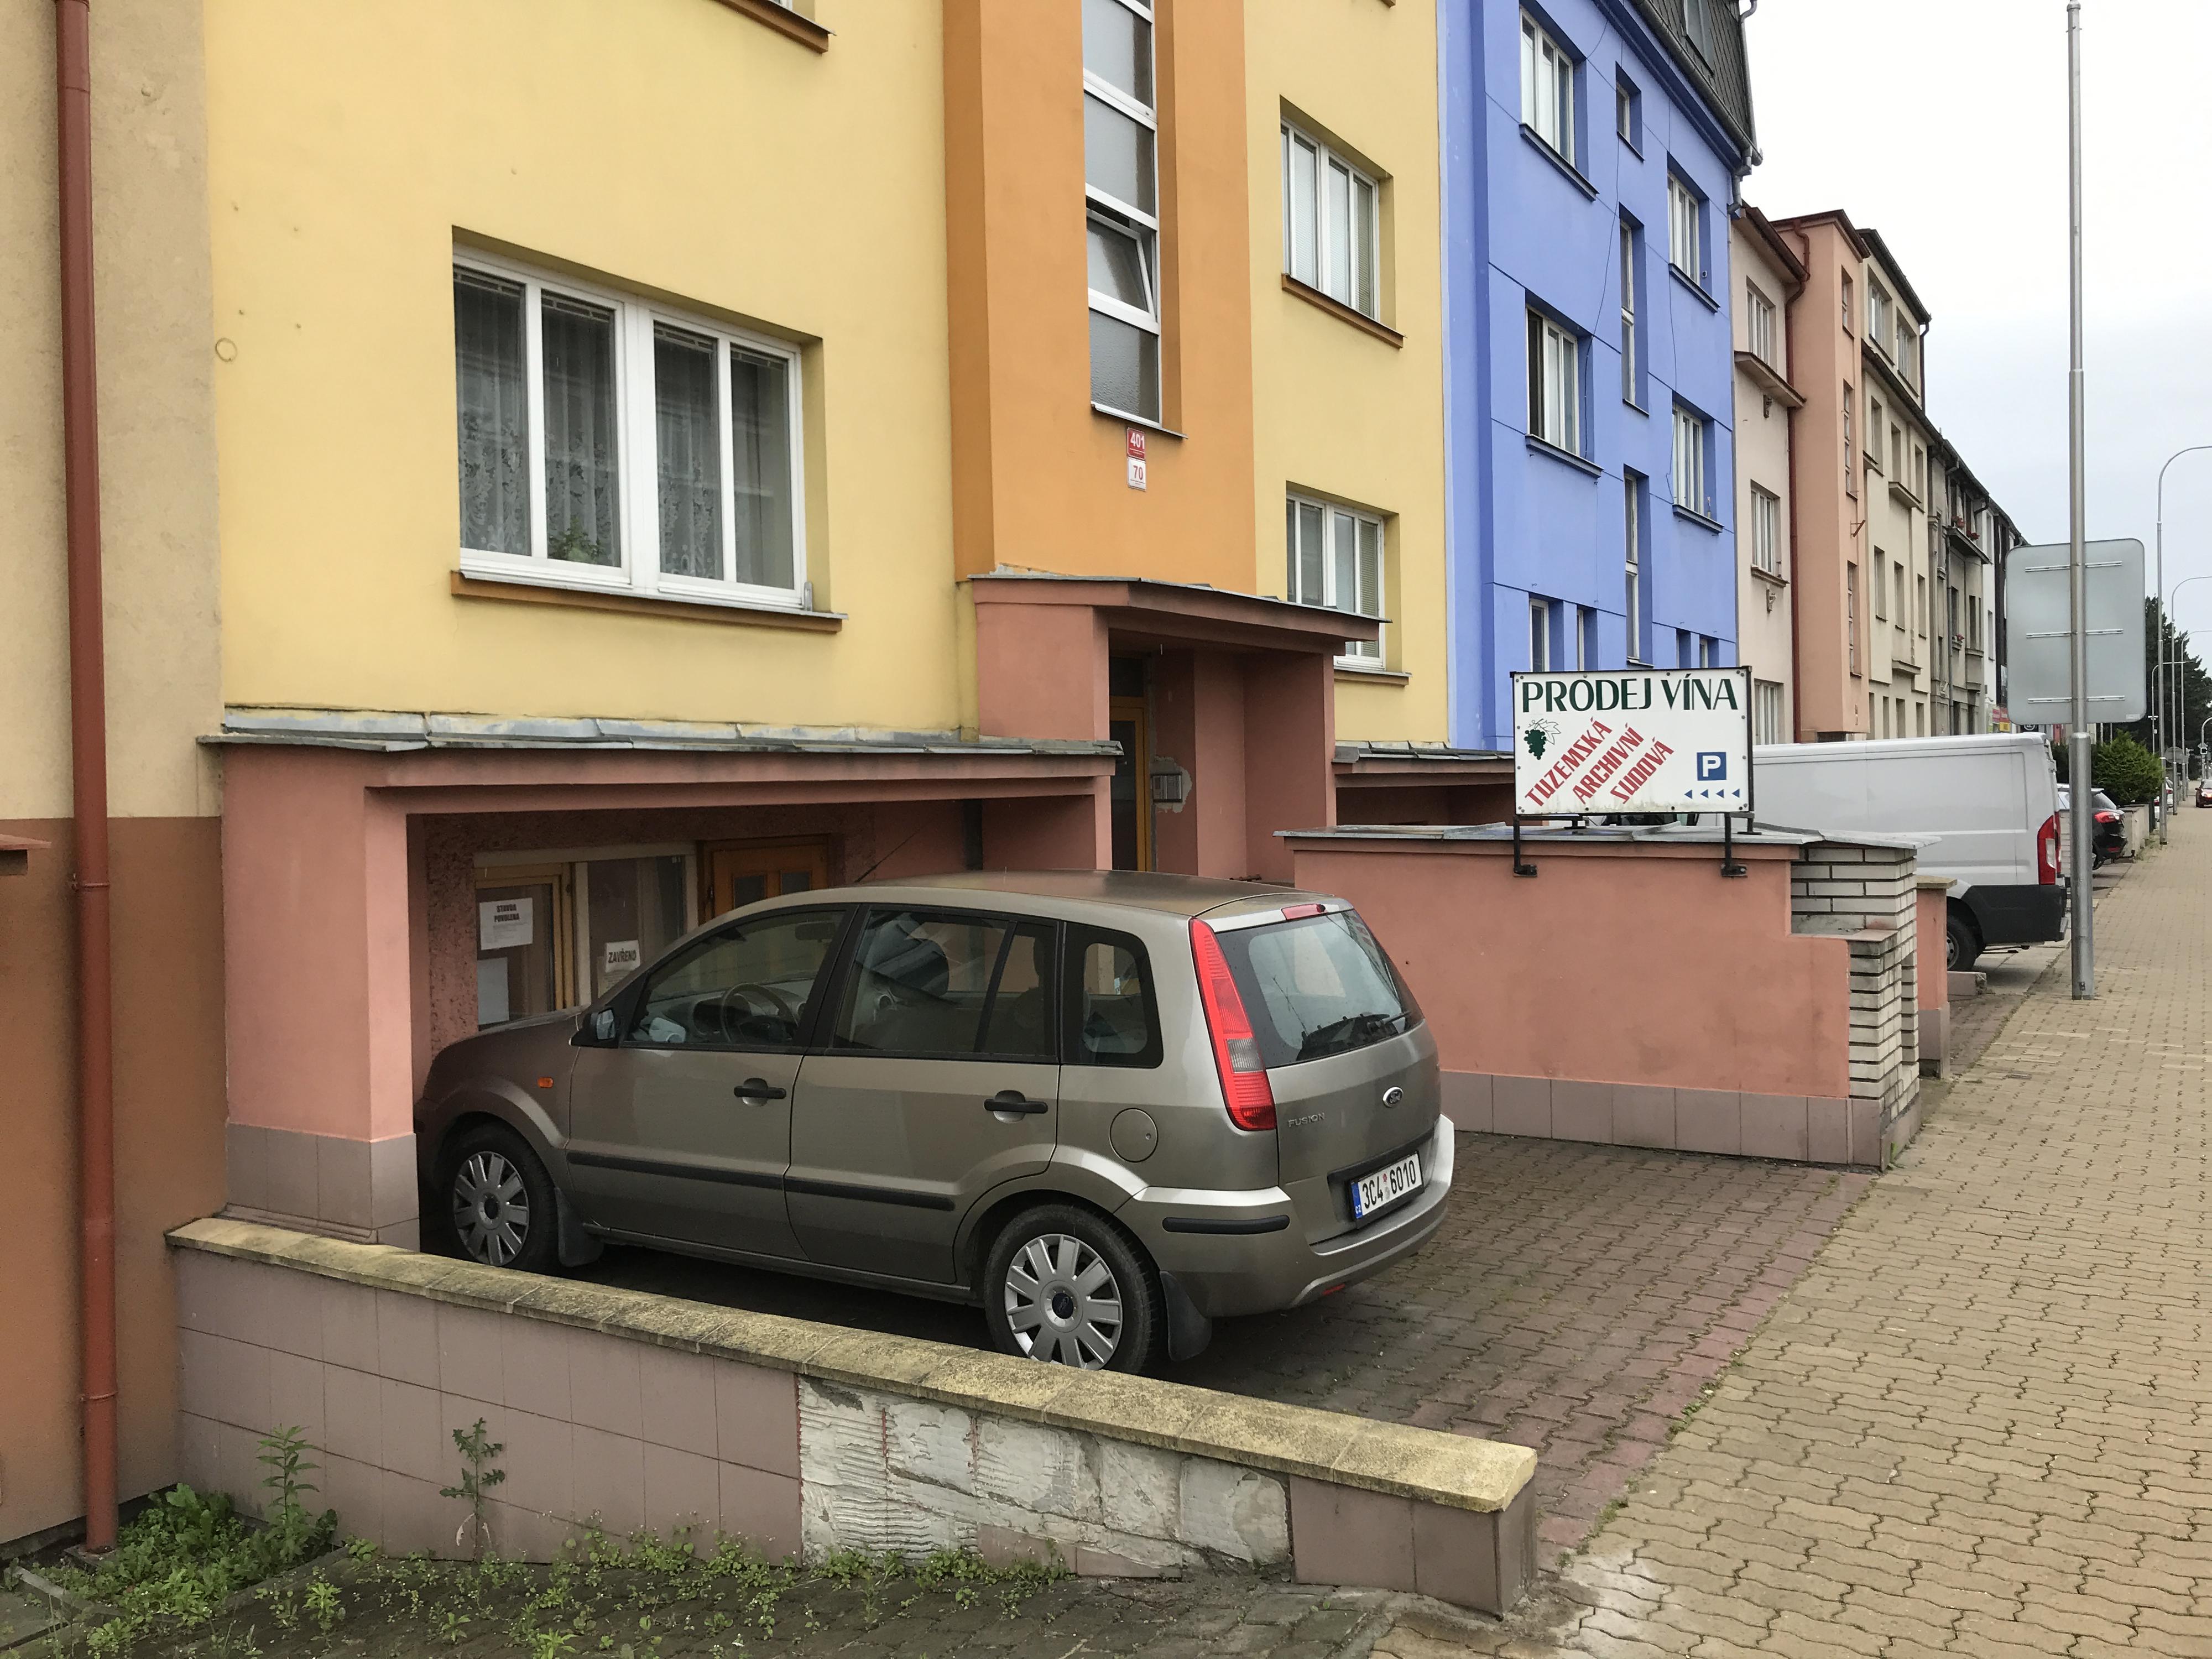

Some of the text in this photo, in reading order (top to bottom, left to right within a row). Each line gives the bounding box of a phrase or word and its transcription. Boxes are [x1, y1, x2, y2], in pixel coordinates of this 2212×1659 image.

[1130, 432, 1145, 450] 401
[1133, 465, 1144, 481] 70
[1522, 673, 1739, 713] PRODEJ VÍNA
[1524, 716, 1613, 807] TUZEMSKÁ
[1572, 722, 1645, 805] ARCHIVNÍ
[1610, 736, 1674, 805] SUDOVÁ
[1702, 754, 1720, 778] P
[608, 947, 637, 963] ZAVŘENO
[1287, 1112, 1326, 1128] FUSION
[1362, 1160, 1416, 1209] 3C4 6010
